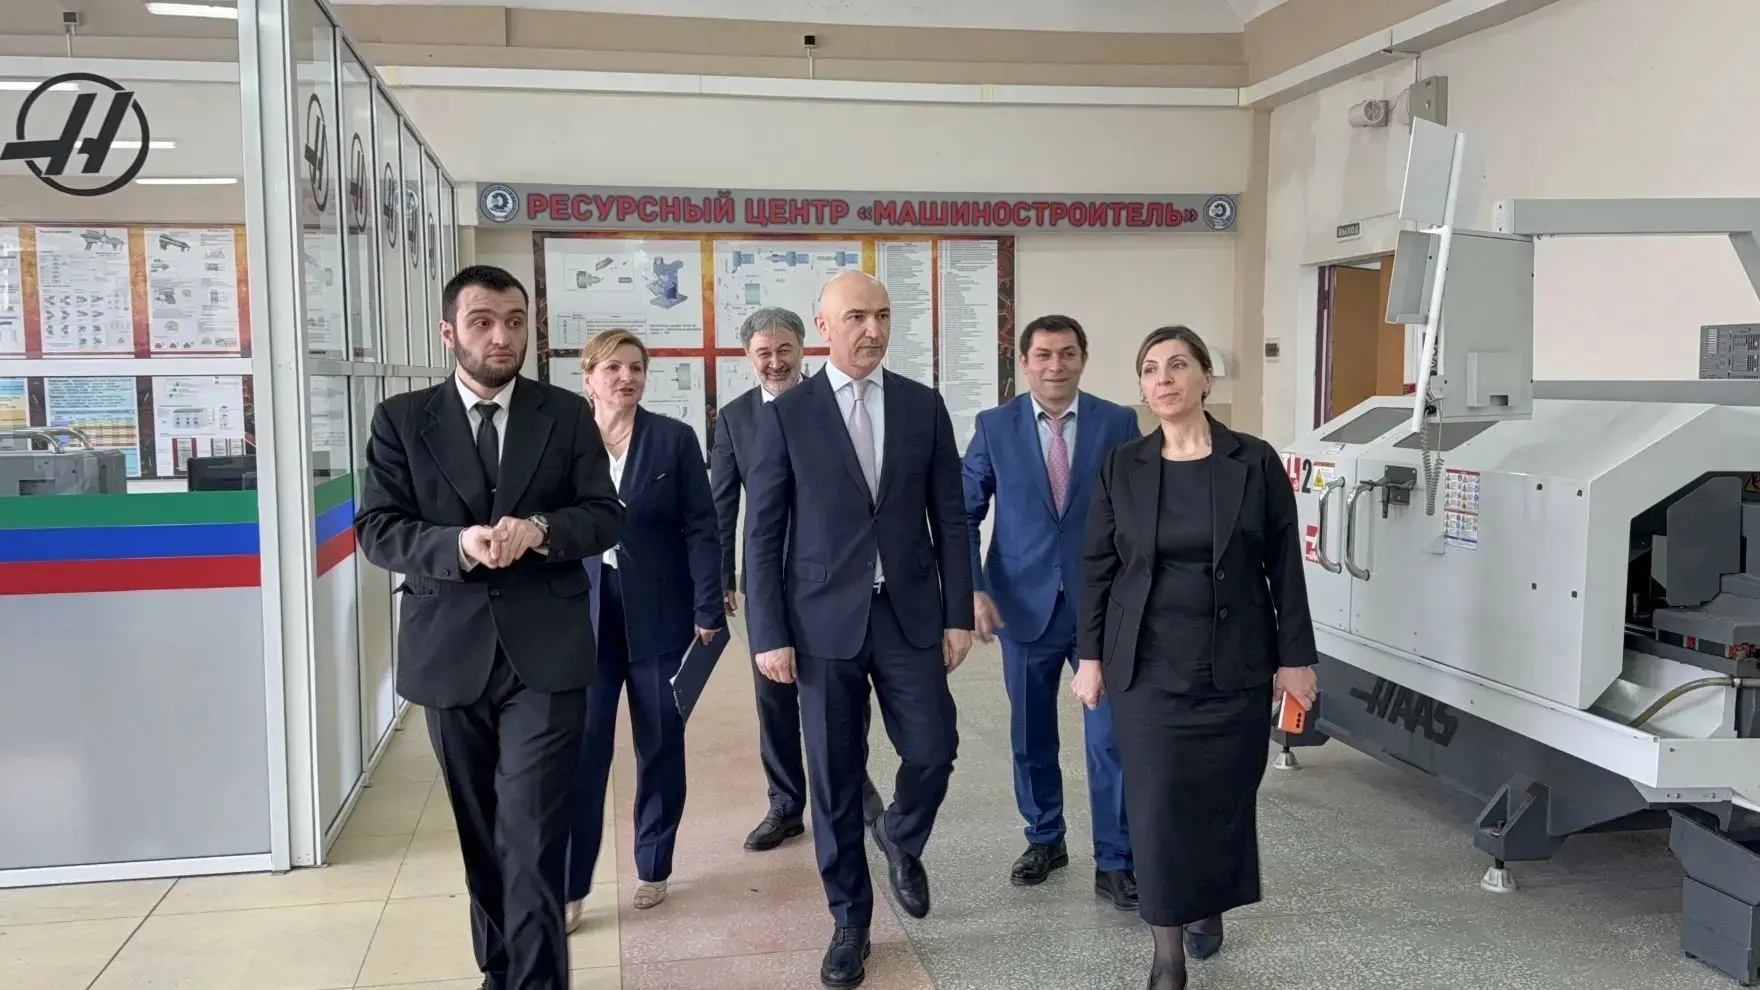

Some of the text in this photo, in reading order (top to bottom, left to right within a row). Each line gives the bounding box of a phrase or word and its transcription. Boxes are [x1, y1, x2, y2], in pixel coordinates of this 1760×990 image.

[526, 190, 736, 223] РЕСУРСНЫЙ
[744, 197, 850, 226] ЦЕНТР
[857, 200, 1198, 228] «МАШИНОСТРОИТЕЛЬ»
[1302, 458, 1312, 494] 2
[1349, 678, 1459, 748] HAAS
